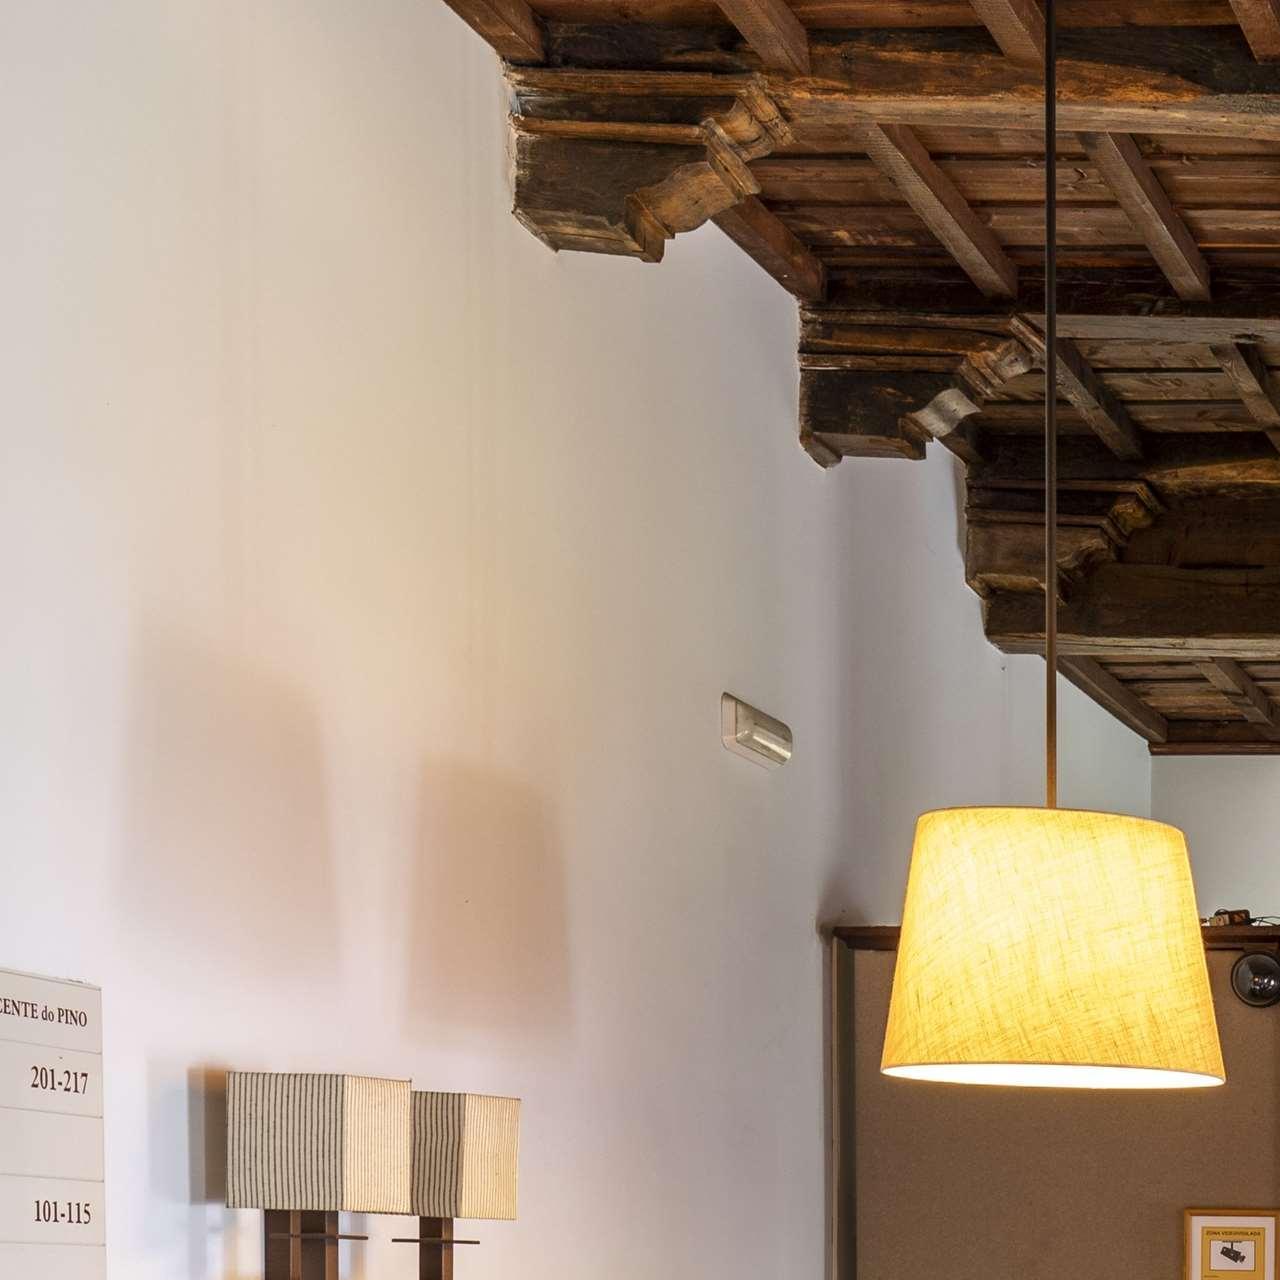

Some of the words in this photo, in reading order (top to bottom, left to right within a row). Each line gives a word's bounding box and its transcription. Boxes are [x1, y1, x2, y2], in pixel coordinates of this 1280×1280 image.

[41, 1005, 55, 1022] do
[57, 1007, 88, 1027] PINO
[31, 1065, 88, 1094] 201-217
[34, 1200, 91, 1225] 101-115
